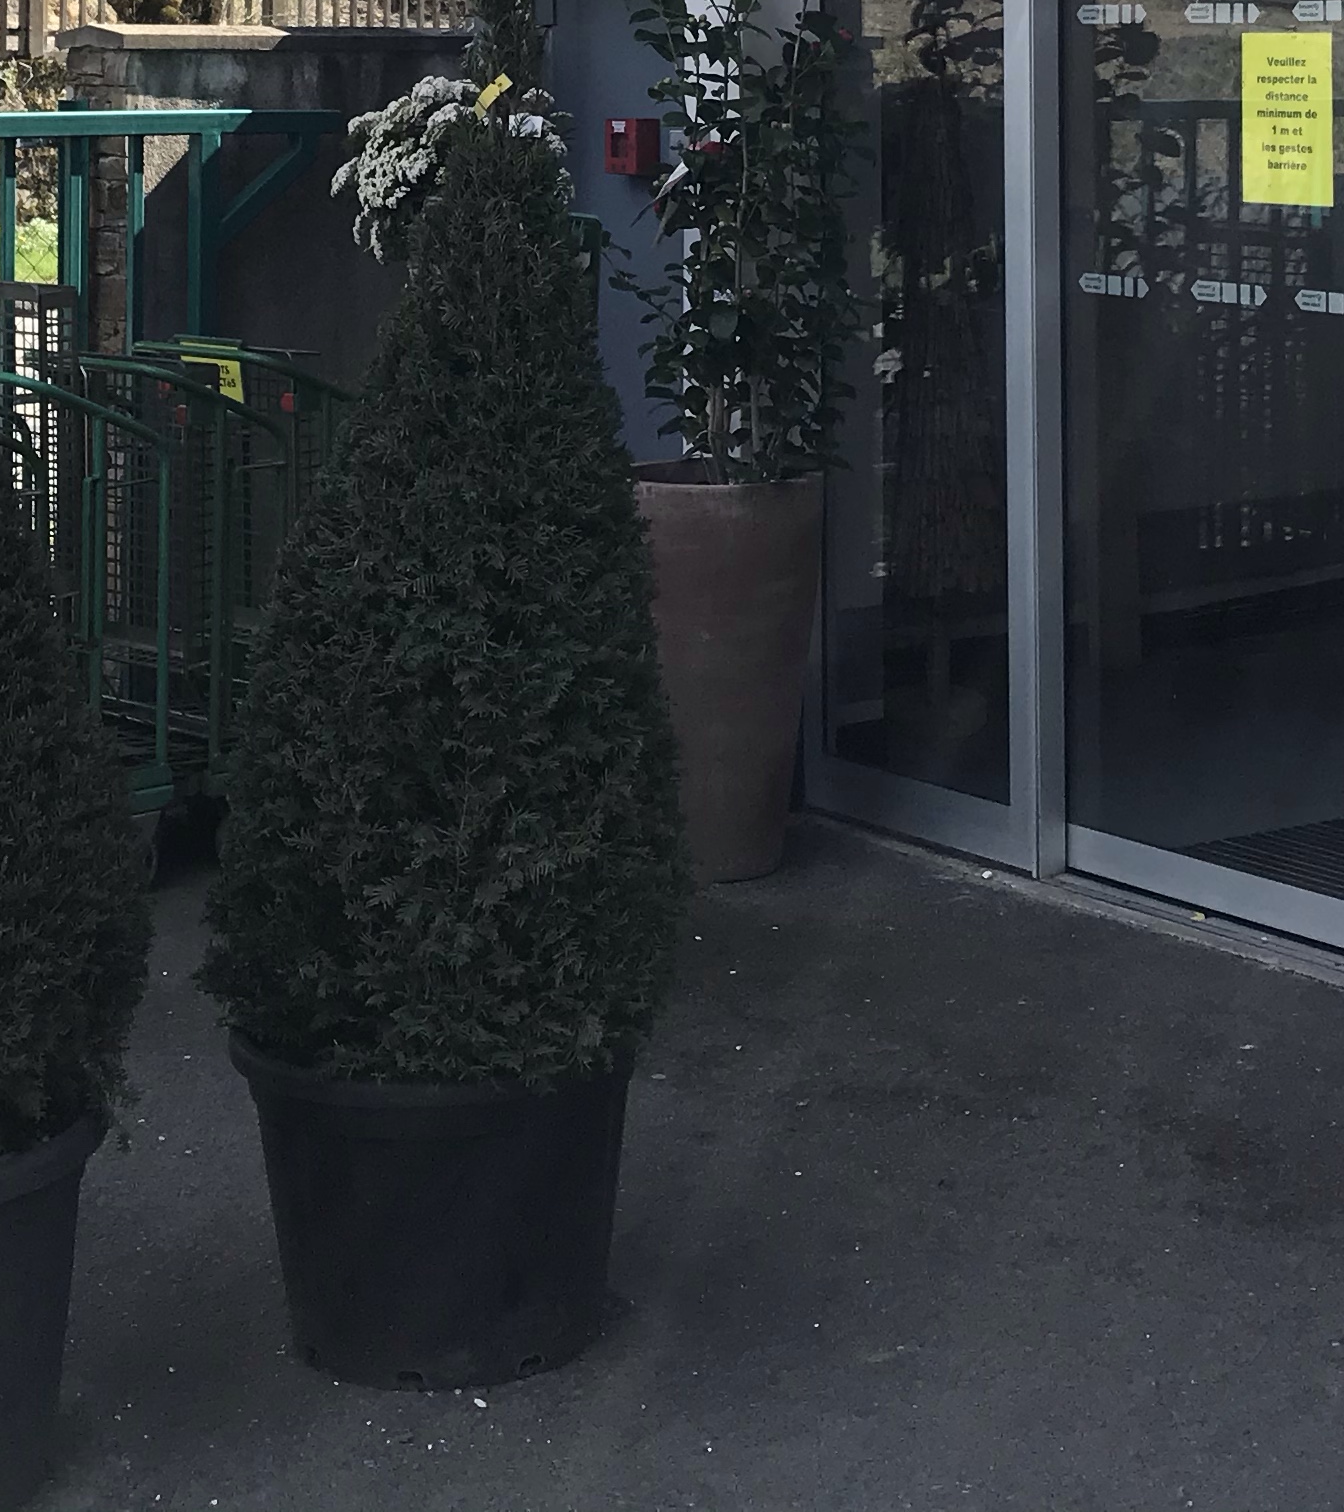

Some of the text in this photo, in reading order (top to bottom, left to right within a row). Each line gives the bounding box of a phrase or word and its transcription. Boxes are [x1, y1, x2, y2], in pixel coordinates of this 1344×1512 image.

[1266, 56, 1307, 67] Veuillez
[1256, 74, 1317, 85] respecter la
[1265, 91, 1308, 102] distance
[1256, 107, 1318, 119] minimum de
[1280, 127, 1289, 135] m
[1292, 127, 1303, 136] et
[1261, 141, 1313, 155] les gestes
[1267, 159, 1307, 171] barrière
